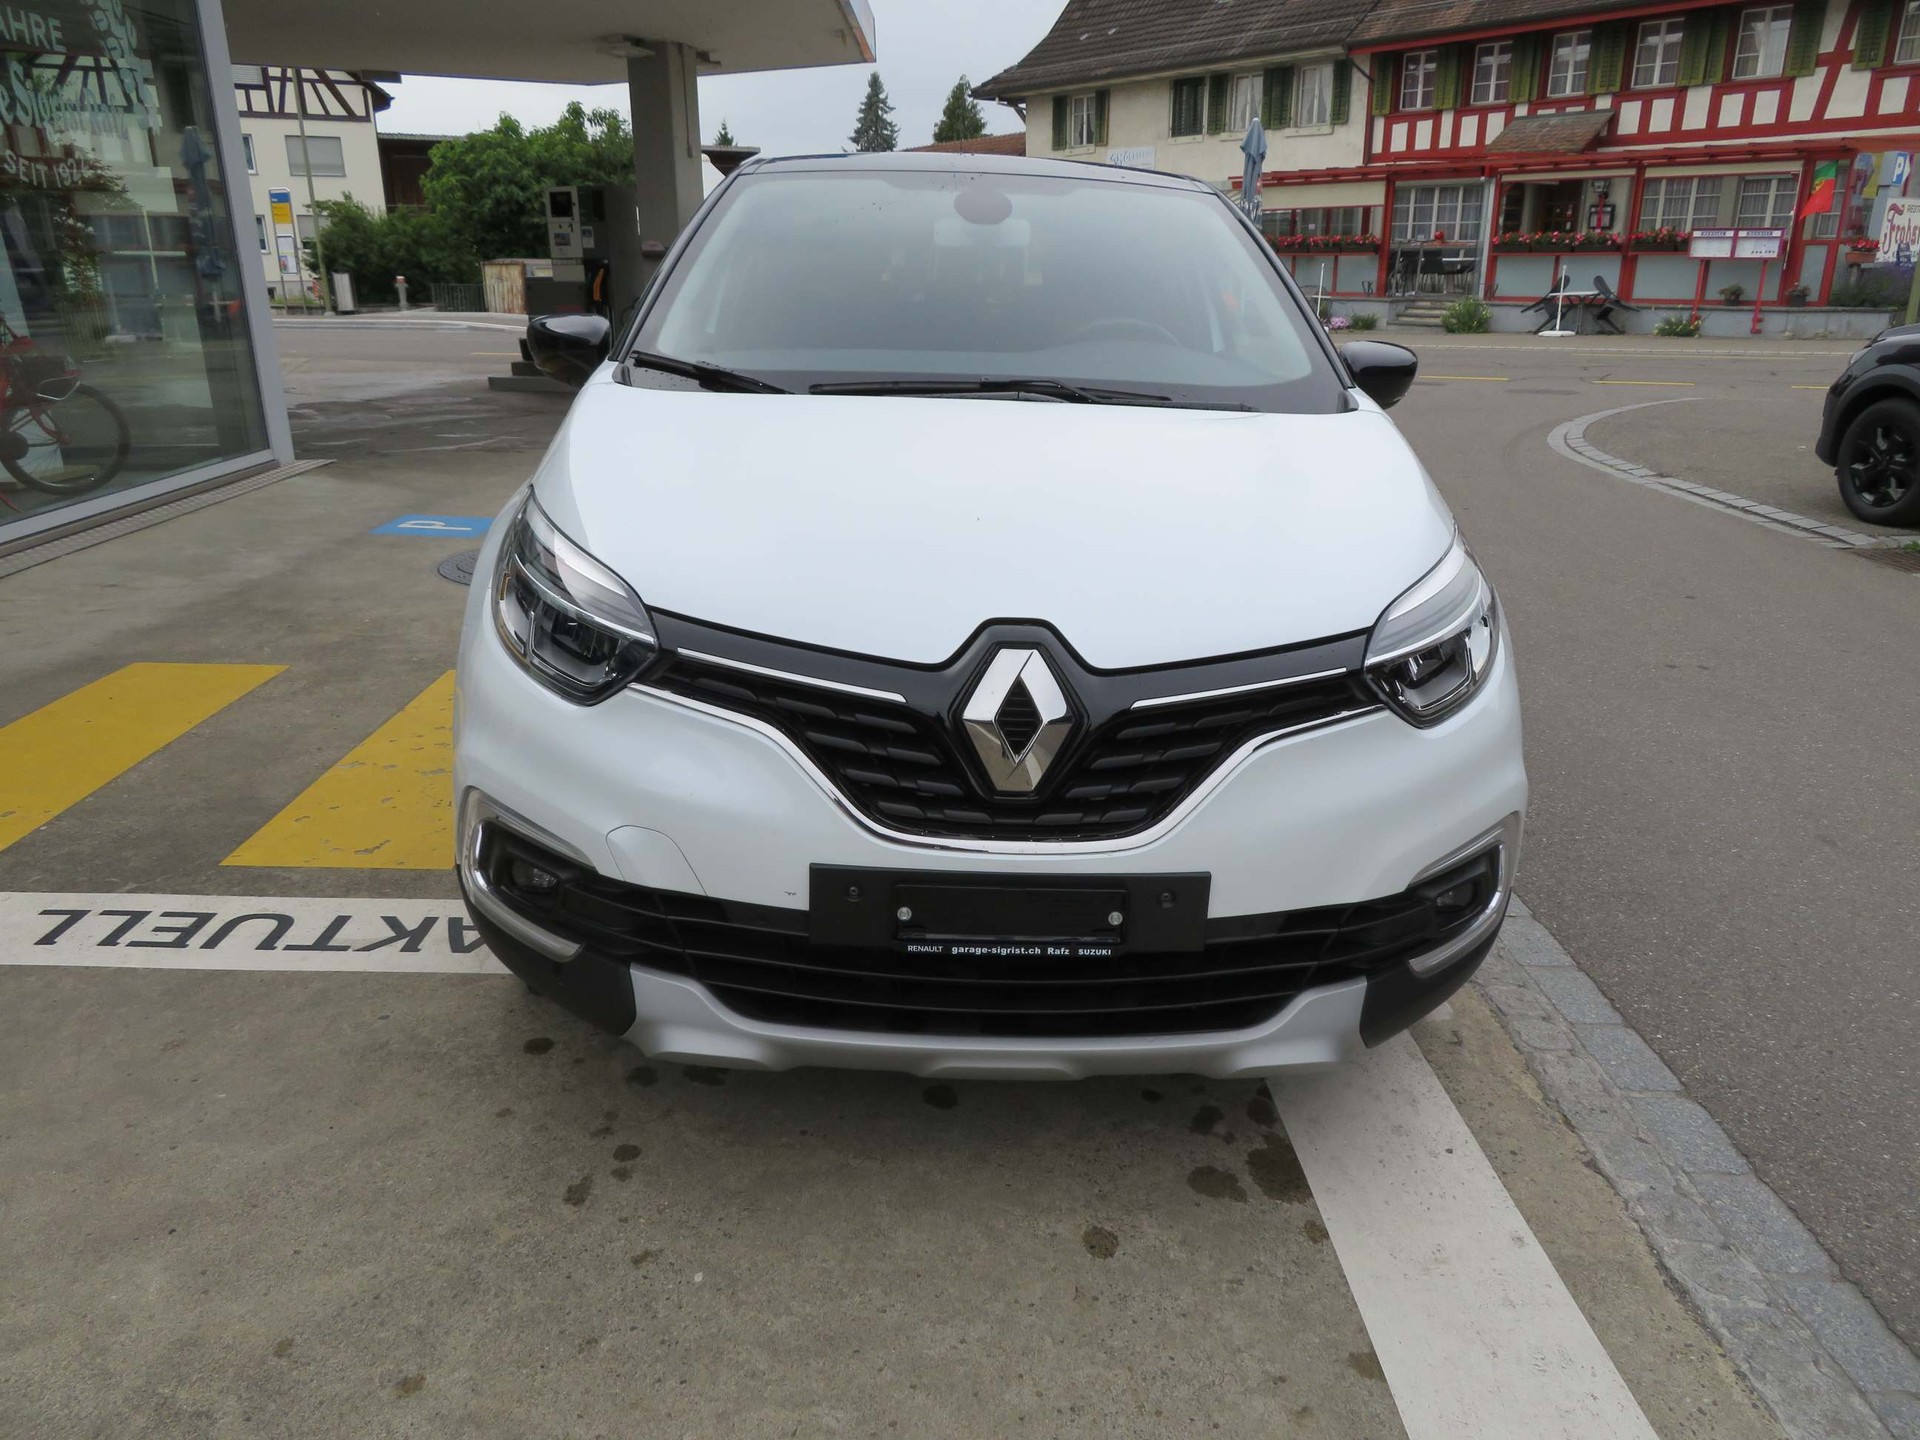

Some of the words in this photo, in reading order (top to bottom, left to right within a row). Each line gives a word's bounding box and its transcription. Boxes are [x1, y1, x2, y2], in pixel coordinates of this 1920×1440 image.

[3, 149, 49, 189] SEIT
[1892, 156, 1905, 182] P
[907, 944, 943, 953] RENAULT
[951, 945, 1041, 957] garage-sigrist.ch
[1047, 946, 1070, 956] Rafz
[1078, 947, 1112, 957] SUZUKI
